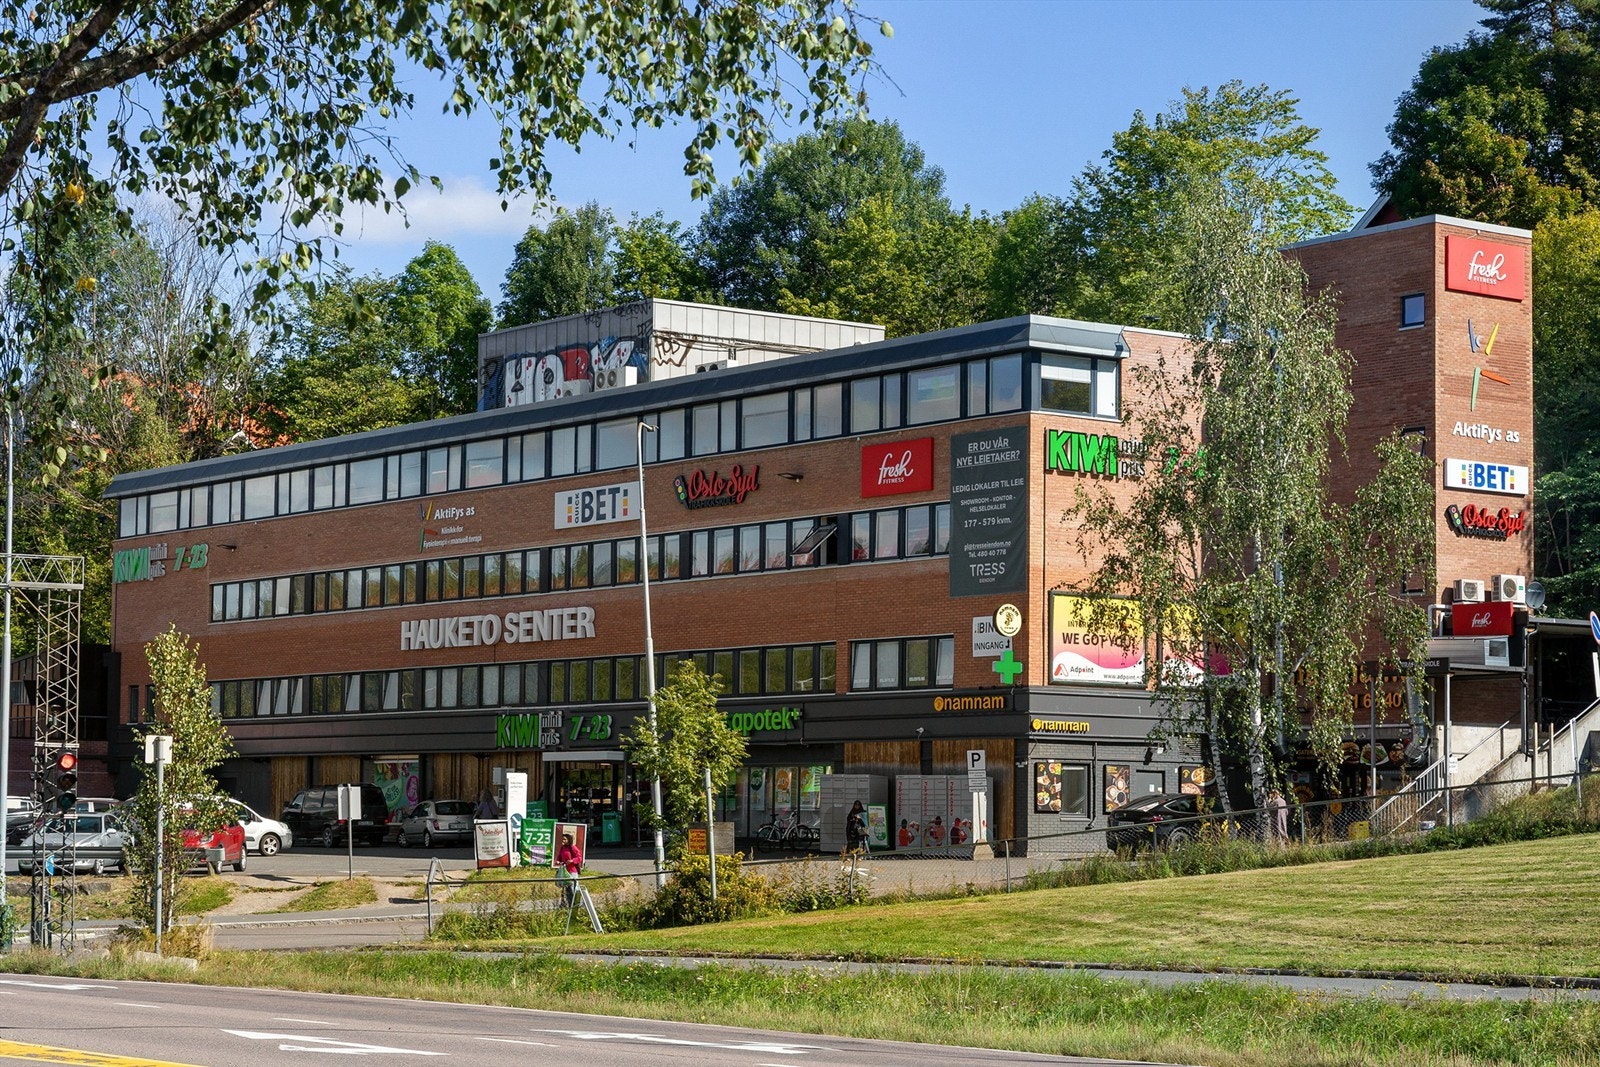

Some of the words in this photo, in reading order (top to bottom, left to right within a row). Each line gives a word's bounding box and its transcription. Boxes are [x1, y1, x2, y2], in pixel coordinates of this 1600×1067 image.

[1468, 250, 1507, 280] fresh
[1473, 276, 1497, 285] FITNESS
[1452, 421, 1502, 443] AktiFys
[1506, 430, 1520, 443] as
[967, 443, 979, 452] ER
[980, 440, 992, 450] DU
[993, 436, 1009, 449] VÅR
[956, 456, 973, 467] NYE
[974, 450, 1020, 465] LEIETAKER?
[1047, 429, 1119, 477] KIWI
[877, 450, 914, 485] fresh
[687, 468, 726, 500] Oslo
[726, 464, 760, 505] Syd
[882, 477, 905, 485] FITNESS
[952, 484, 971, 493] LEDIG
[971, 481, 1000, 491] LOKALER
[1000, 480, 1010, 488] TIL
[1010, 477, 1024, 486] LEIE
[1473, 463, 1509, 490] BET
[581, 487, 621, 523] BET
[960, 497, 990, 506] SHOWROOM
[992, 494, 1013, 502] KONTOR
[969, 503, 1006, 513] HELSELOKALER
[433, 507, 464, 520] AktiFys
[465, 507, 475, 516] as
[1462, 503, 1496, 527] Oslo
[1498, 507, 1526, 537] Syd
[964, 519, 978, 528] 177
[982, 517, 996, 526] 579
[149, 543, 168, 560] mini
[173, 543, 209, 571] 7-23
[113, 547, 150, 583] KIWI
[149, 561, 166, 581] pris
[969, 562, 1006, 577] TRESS
[400, 613, 502, 650] HAUKETO
[503, 606, 596, 644] SENTER
[1471, 612, 1492, 628] fresh
[974, 641, 1004, 650] INNGANG
[1062, 632, 1080, 645] WE
[1082, 633, 1106, 648] GOT
[944, 696, 1004, 711] namnam
[1385, 692, 1402, 708] 40
[541, 710, 563, 728] mini
[569, 714, 613, 740] 7-23
[1041, 720, 1090, 732] namnam
[497, 713, 542, 748] KIWI
[541, 728, 561, 749] pris
[971, 752, 981, 768] P
[525, 832, 551, 844] 7-23
